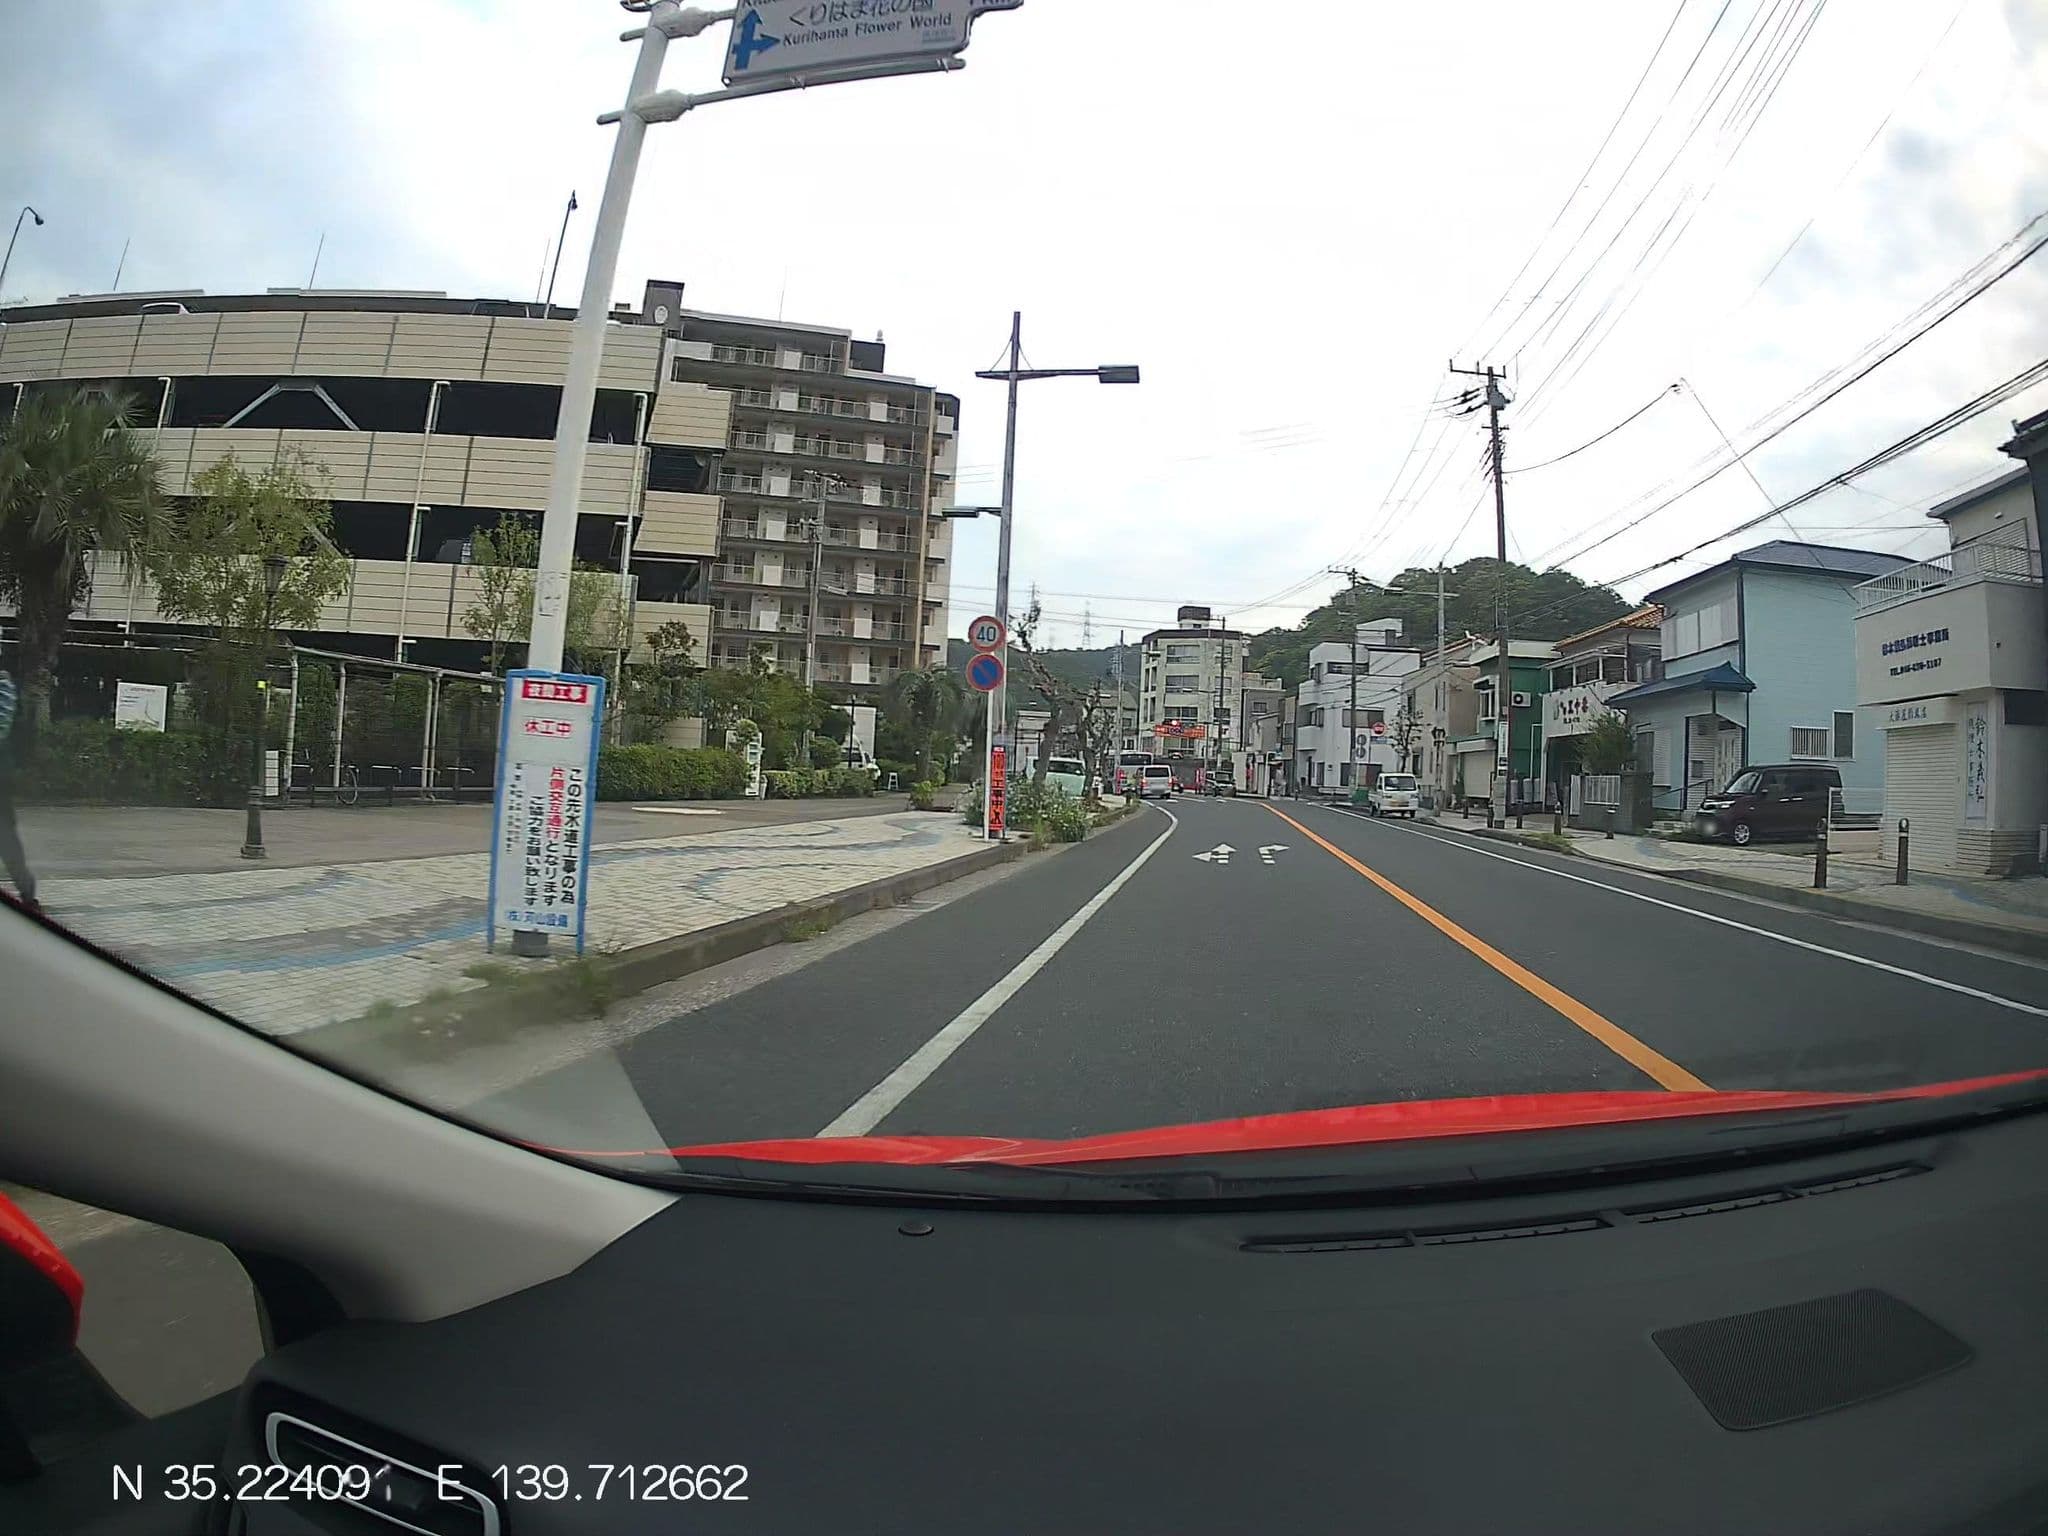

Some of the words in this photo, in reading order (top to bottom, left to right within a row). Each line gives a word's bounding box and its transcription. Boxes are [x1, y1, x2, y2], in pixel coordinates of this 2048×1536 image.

[782, 26, 849, 46] Kurihama
[855, 19, 902, 37] Flower
[908, 13, 953, 29] World
[976, 626, 997, 642] 40
[525, 719, 572, 736] 休工中
